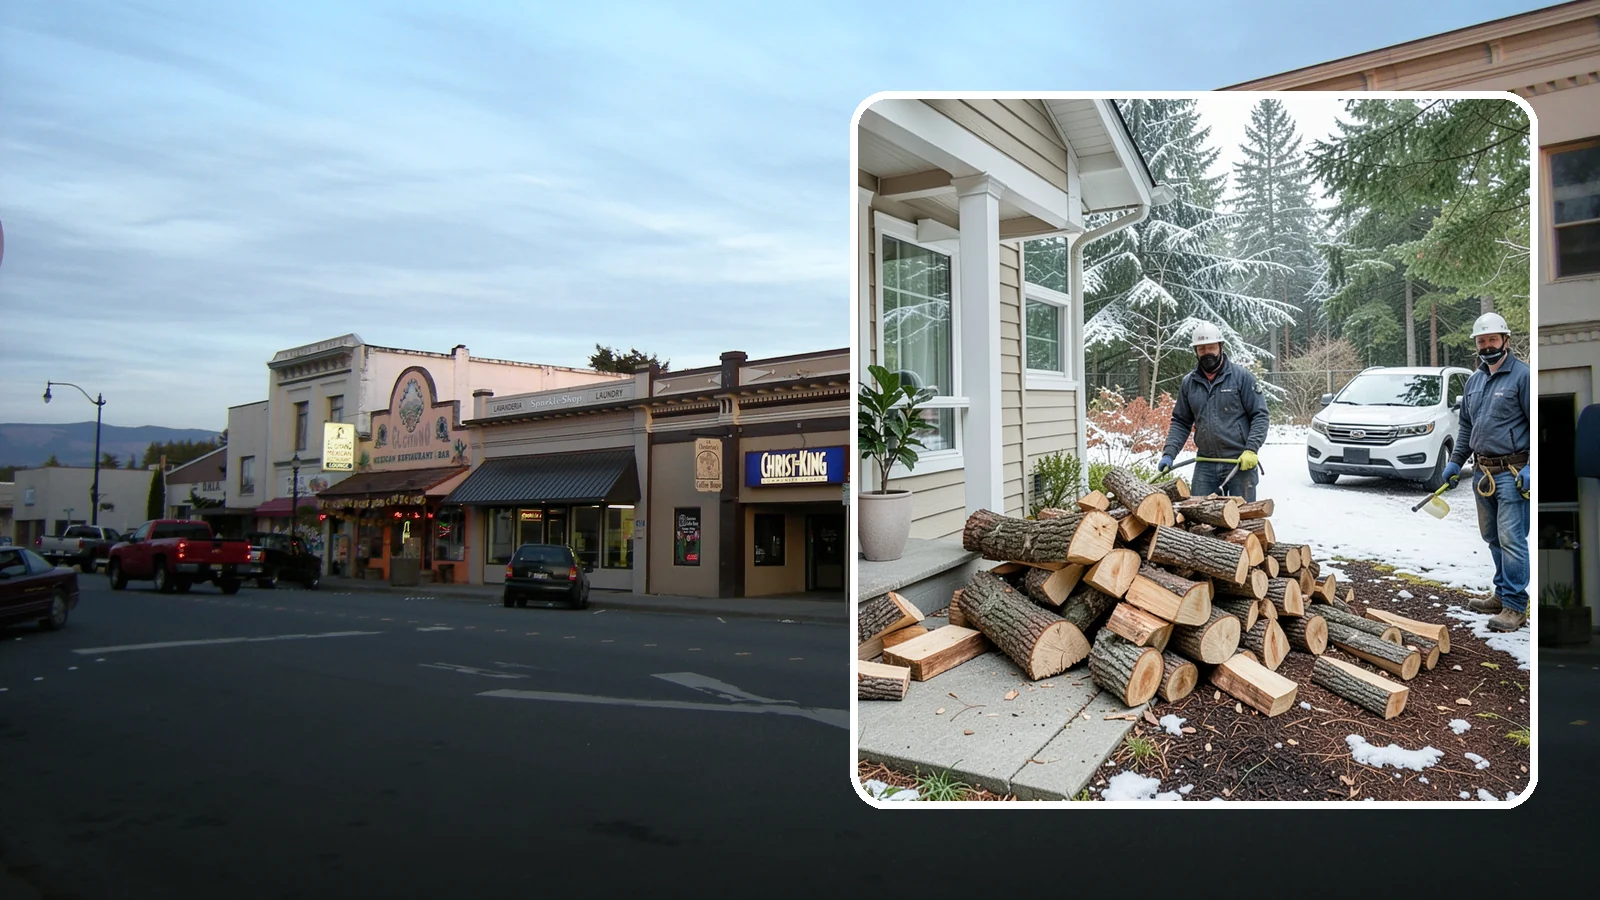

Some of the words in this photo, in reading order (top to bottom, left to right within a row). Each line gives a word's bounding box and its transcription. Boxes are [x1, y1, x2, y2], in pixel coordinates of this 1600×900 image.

[595, 389, 624, 400] LAUNDRY
[493, 402, 523, 413] LAVANDERIA
[530, 394, 561, 409] Sparkle
[561, 394, 583, 406] Shop
[373, 455, 396, 464] MEXICAN
[397, 451, 434, 462] RESTAURANT
[437, 450, 450, 459] BAR
[760, 451, 797, 478] CHRIST
[798, 449, 827, 476] KING
[696, 480, 709, 488] Coffee
